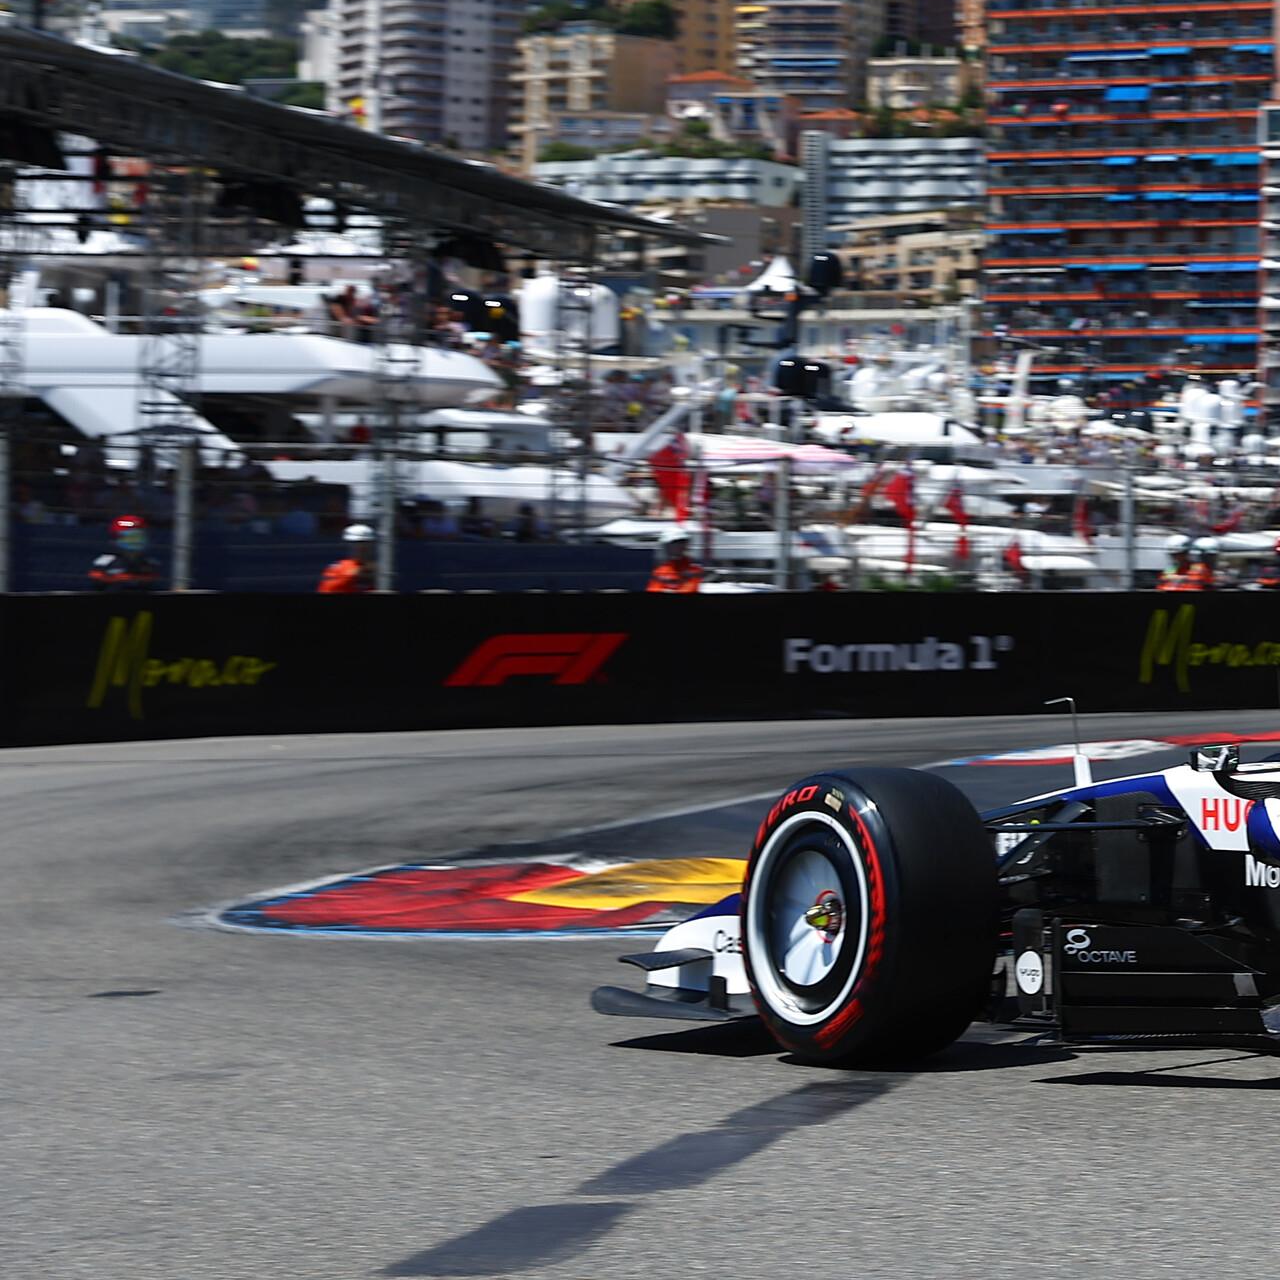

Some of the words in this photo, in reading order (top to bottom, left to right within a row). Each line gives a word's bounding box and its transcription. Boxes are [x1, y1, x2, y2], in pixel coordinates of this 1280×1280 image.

[784, 637, 964, 672] Formula
[1201, 798, 1257, 832] HU
[1077, 950, 1138, 963] OCTAVE
